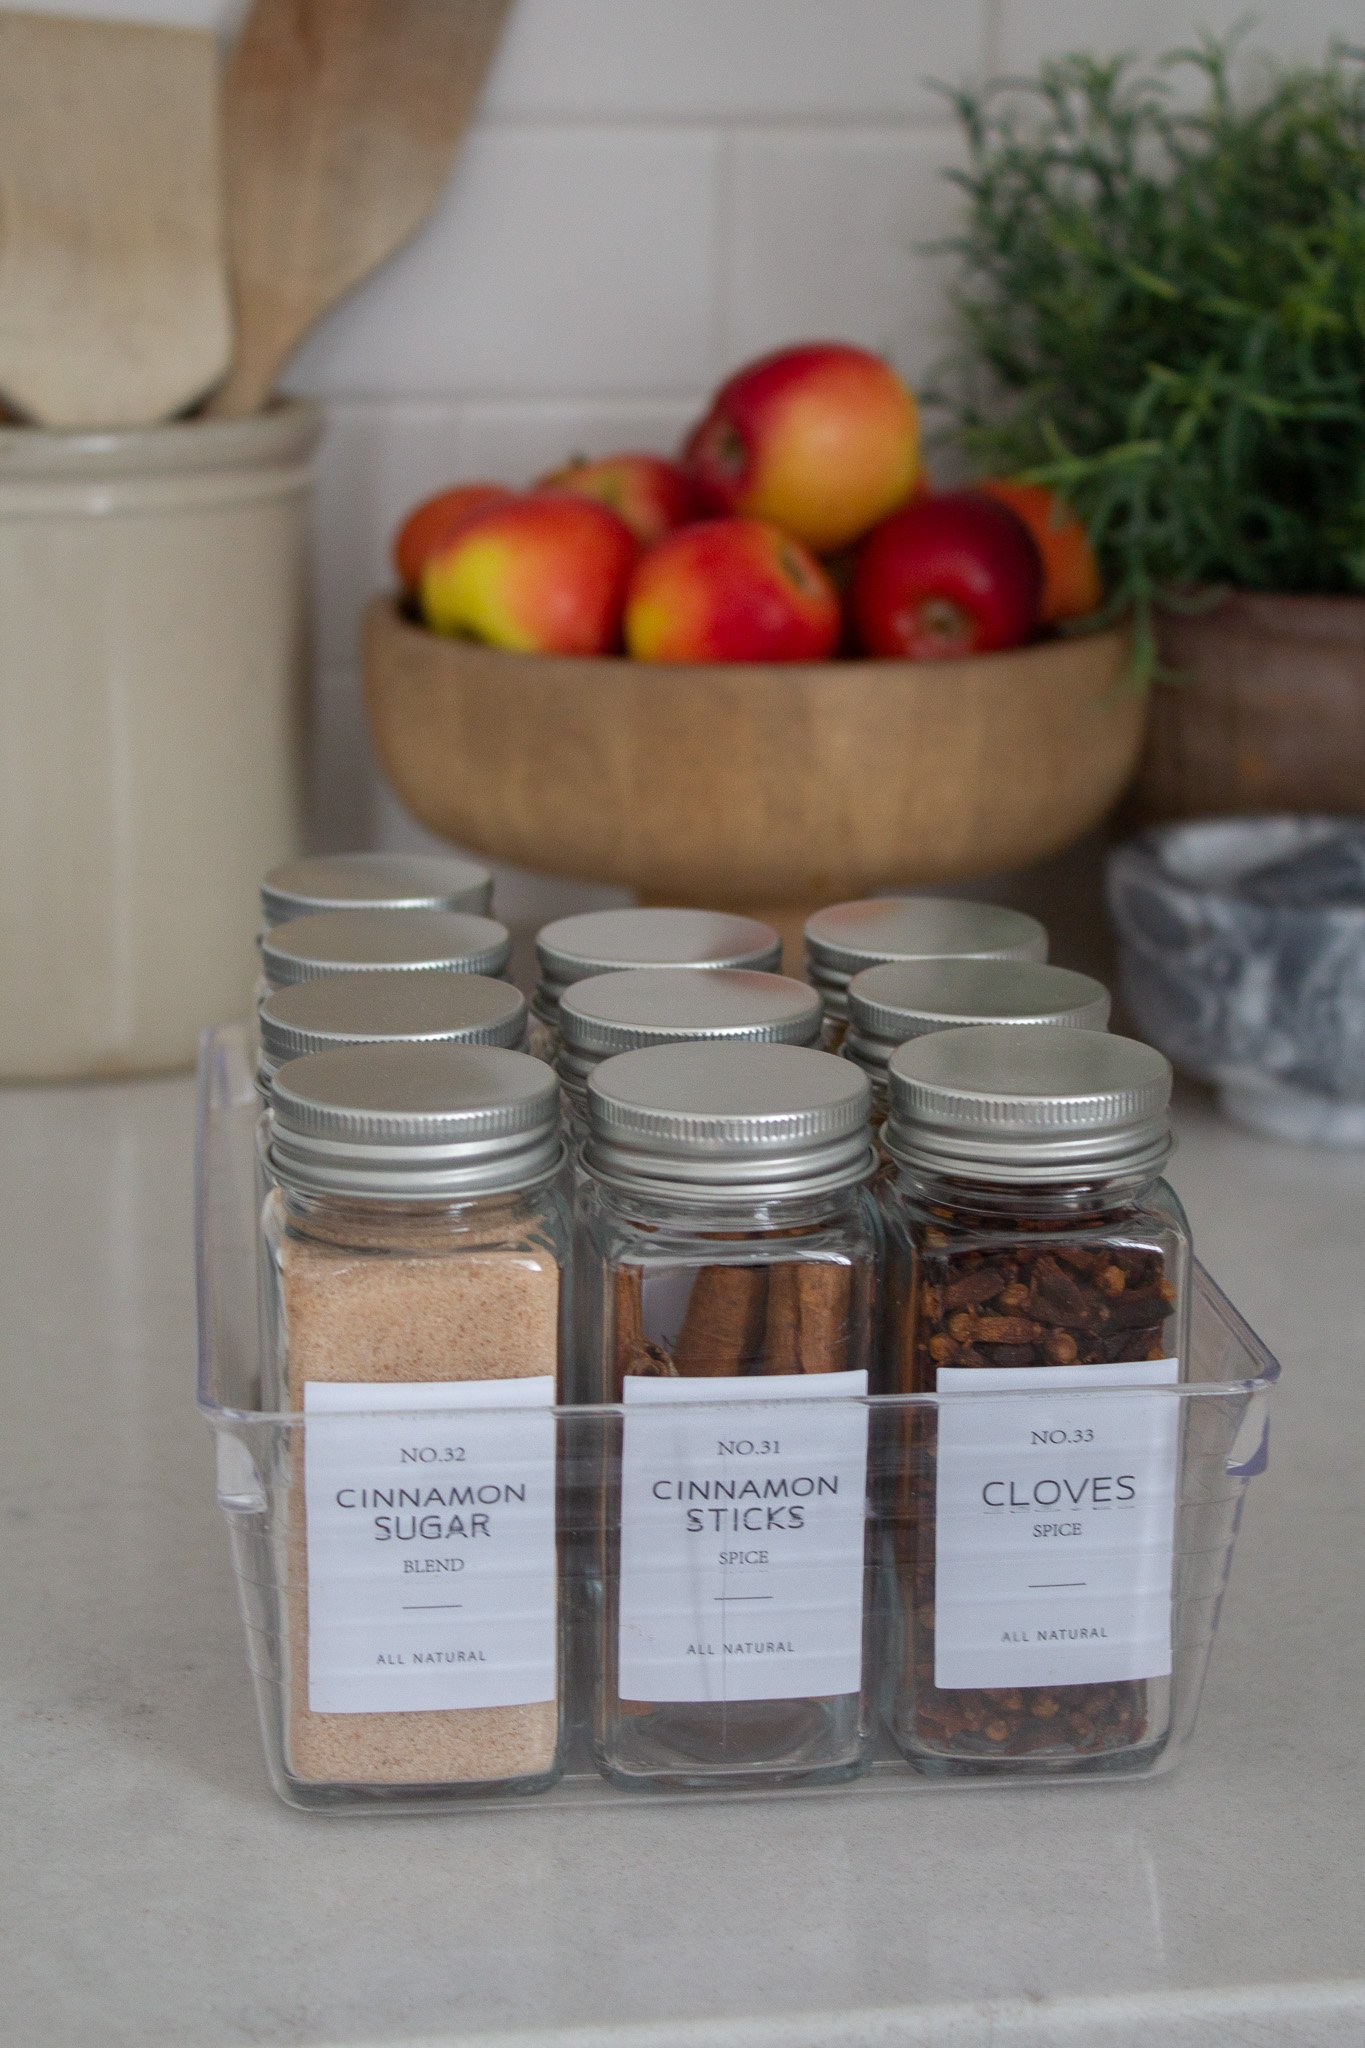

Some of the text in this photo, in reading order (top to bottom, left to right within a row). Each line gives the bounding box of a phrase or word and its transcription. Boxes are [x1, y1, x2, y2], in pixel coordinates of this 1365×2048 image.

[1030, 1428, 1095, 1445] NO.33
[400, 1446, 466, 1464] NO.32
[716, 1439, 781, 1456] NO.31
[335, 1483, 526, 1509] CINNAMON
[652, 1475, 839, 1501] CINNAMON
[981, 1474, 1136, 1507] CLOVES
[374, 1512, 492, 1541] SUGAR
[685, 1505, 805, 1533] STICKS
[1032, 1522, 1083, 1538] SPICE
[403, 1558, 465, 1574] BLEND
[718, 1550, 770, 1566] SPICE
[1001, 1627, 1108, 1643] ALL NATURAL
[685, 1641, 795, 1656] ALL NATURAL
[376, 1650, 487, 1665] ALL NATURAL
